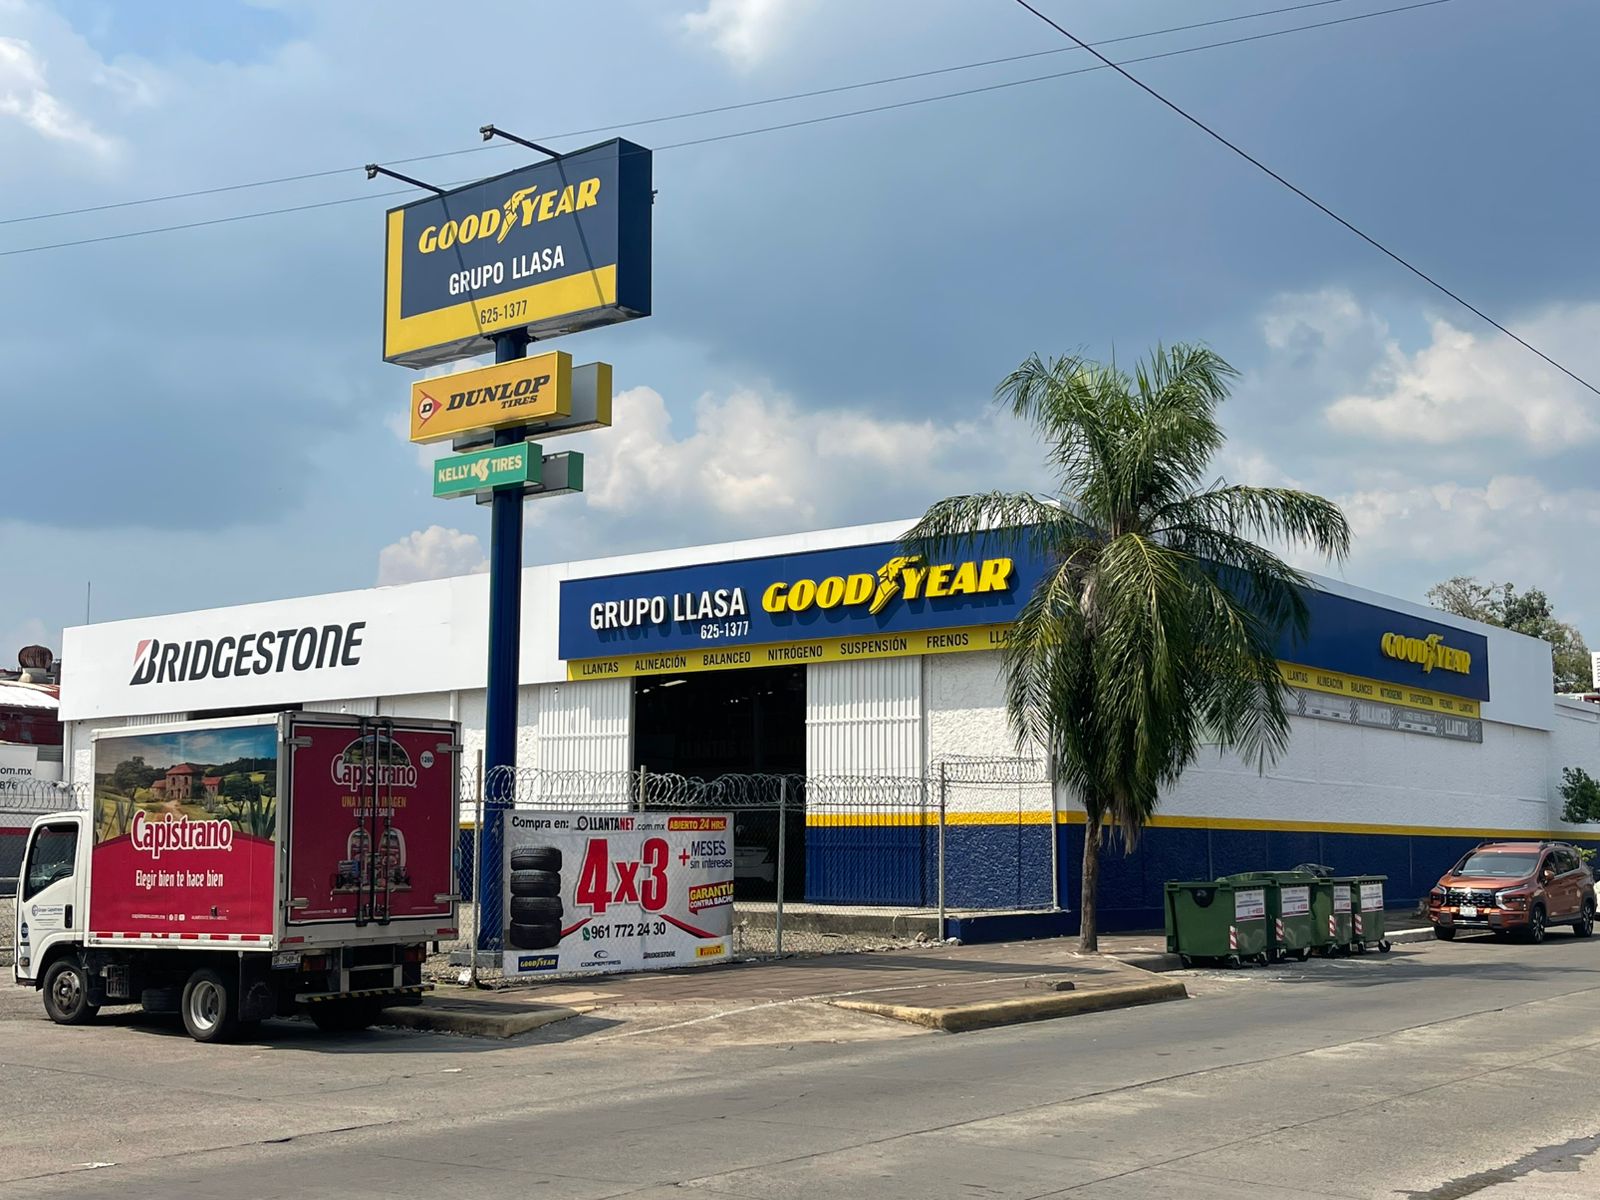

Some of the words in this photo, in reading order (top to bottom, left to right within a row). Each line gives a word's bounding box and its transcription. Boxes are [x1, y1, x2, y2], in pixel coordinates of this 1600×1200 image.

[418, 177, 601, 254] GOODYEAR
[449, 261, 504, 295] GRUPO
[512, 245, 565, 280] LLASA
[480, 300, 528, 325] 625-1377
[446, 374, 551, 411] DUNLOP
[501, 394, 538, 409] TIRES
[438, 463, 470, 483] KELLY
[491, 455, 522, 473] TIRES
[590, 596, 666, 630] GRUPO
[673, 587, 747, 622] LLASA
[761, 557, 1014, 614] GOODYEAR
[700, 620, 749, 639] 625-1377
[129, 621, 367, 686] BRIDGESTONE
[582, 662, 619, 675] LLANTAS
[634, 655, 687, 671] ALINEACIÓN
[703, 651, 751, 666] BALANCEO
[768, 644, 823, 661] NITRÓGENO
[840, 636, 907, 655] SUSPENSIÓN
[926, 633, 969, 649] FRENOS
[1381, 632, 1471, 673] GOODYEAR
[131, 809, 233, 859] Capistrano
[512, 816, 551, 830] Compra
[554, 818, 569, 829] en:
[669, 820, 698, 830] ABIERTO
[699, 819, 710, 830] 24
[691, 840, 727, 857] MESES
[576, 837, 669, 914] 4x3
[690, 858, 700, 869] sin
[701, 858, 733, 869] intereses
[136, 870, 157, 890] Elegir
[158, 869, 174, 887] bien
[176, 870, 185, 887] te
[186, 870, 205, 887] hace
[206, 869, 224, 887] bien
[690, 898, 714, 908] CONTRA
[591, 924, 611, 939] 961
[614, 924, 634, 938] 772
[637, 923, 650, 936] 24
[653, 922, 666, 935] 30
